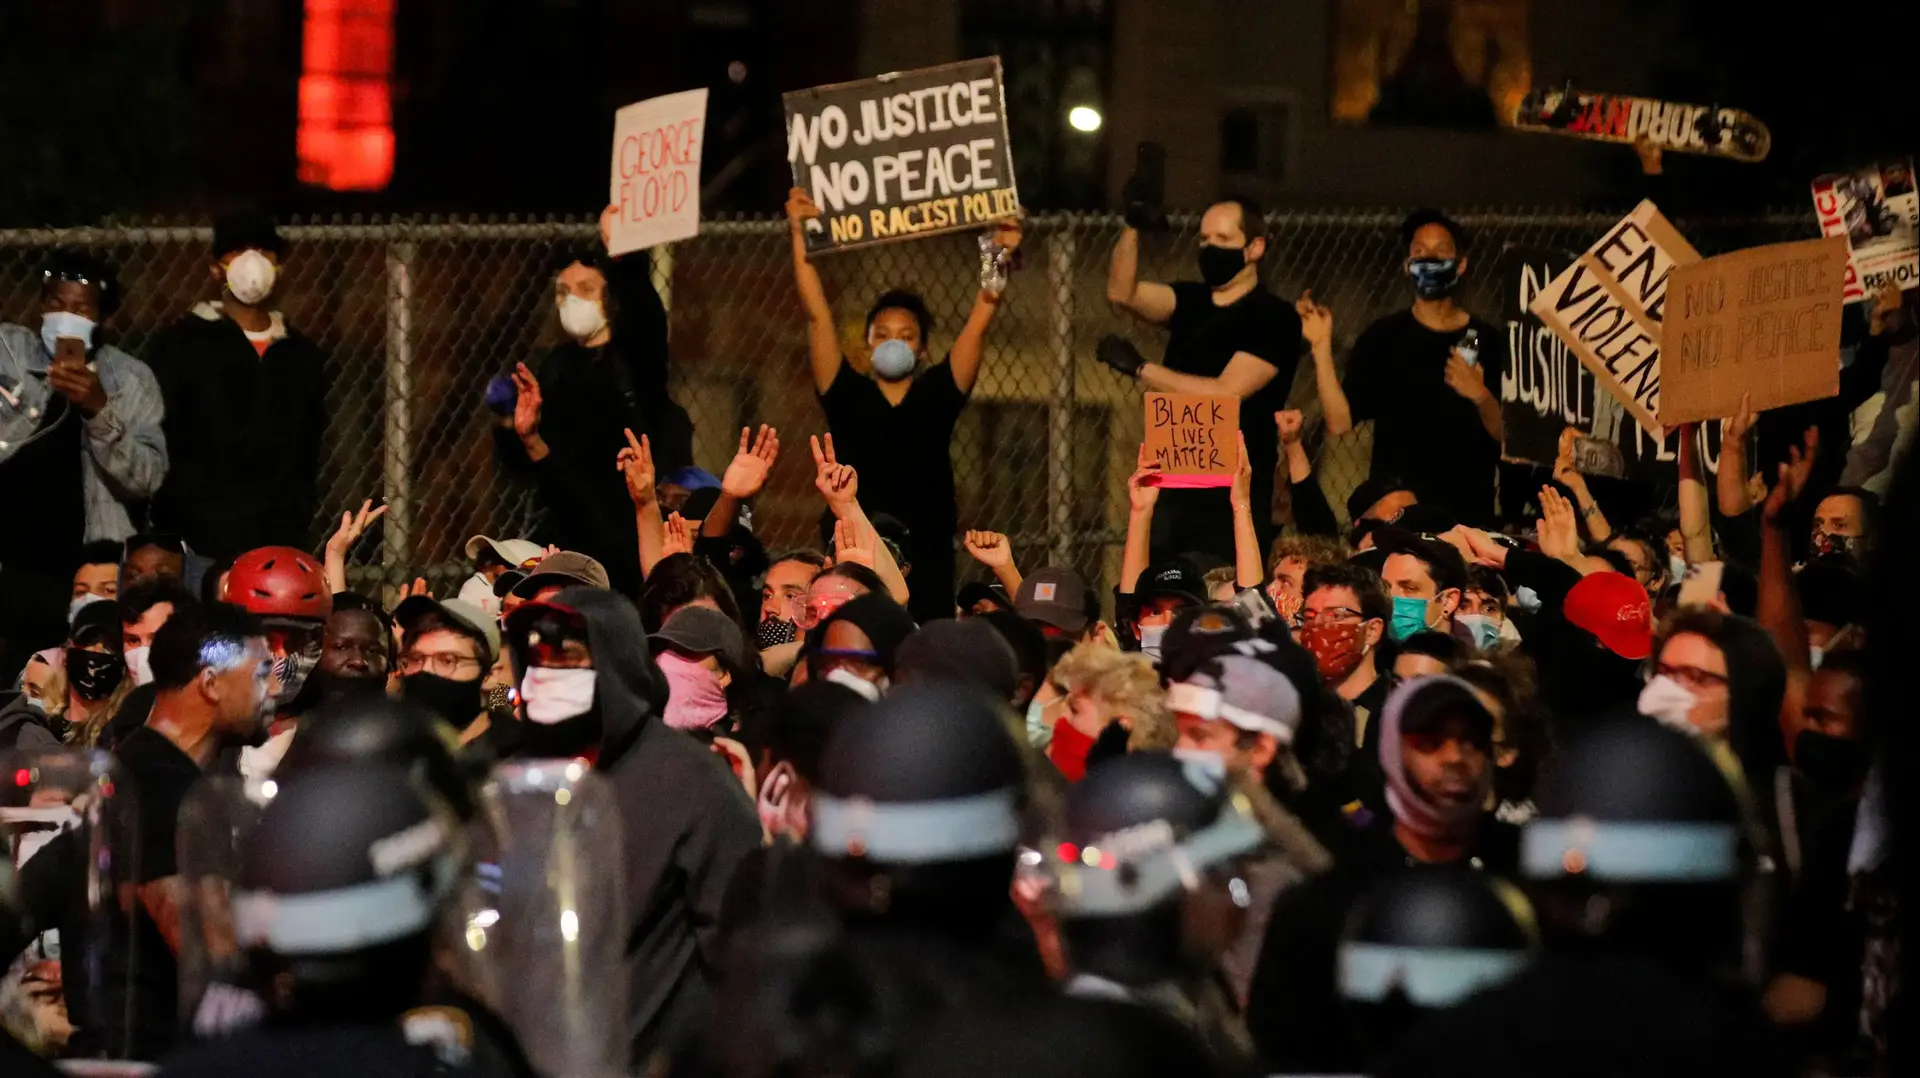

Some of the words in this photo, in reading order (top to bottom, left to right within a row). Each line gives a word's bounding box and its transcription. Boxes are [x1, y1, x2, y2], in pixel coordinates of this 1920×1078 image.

[620, 117, 700, 179] GEORGE
[788, 103, 848, 165] NO
[853, 78, 997, 145] JUSTICE
[620, 170, 688, 225] FLOYD
[810, 160, 870, 213] NO
[874, 138, 998, 204] PEACE
[830, 213, 864, 243] NO
[871, 197, 958, 238] RACIST
[1519, 261, 1552, 316] N
[1685, 276, 1724, 320] NO
[1739, 253, 1829, 309] JUSTICE
[1680, 324, 1723, 374] NO
[1735, 302, 1830, 364] PEACE
[1152, 397, 1225, 428] BLACK
[1171, 427, 1215, 448] LIVES
[1155, 447, 1226, 471] MATTER
